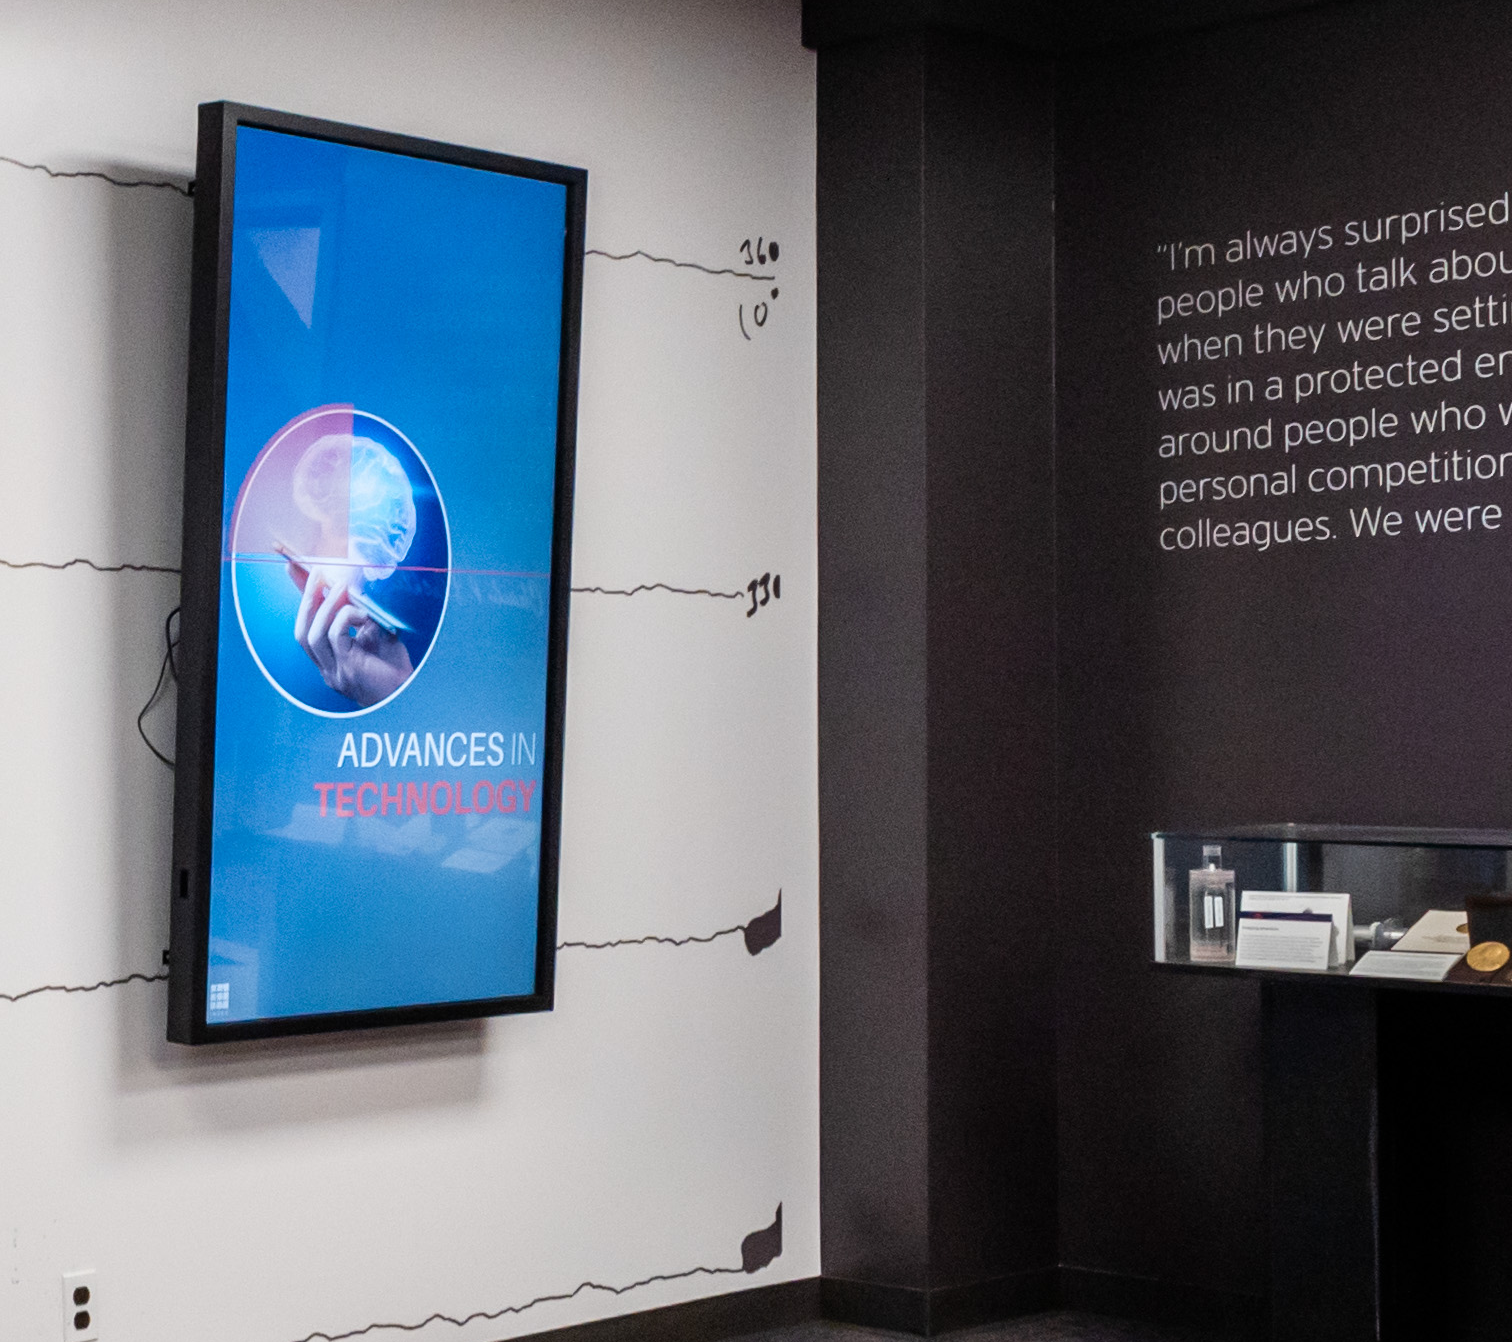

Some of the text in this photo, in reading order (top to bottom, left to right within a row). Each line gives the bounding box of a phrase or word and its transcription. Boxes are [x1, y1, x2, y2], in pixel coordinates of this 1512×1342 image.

[1226, 225, 1332, 263] always
[1345, 192, 1509, 245] surprised
[1158, 280, 1264, 324] people
[1275, 271, 1345, 302] who
[1357, 257, 1417, 293] talk
[1158, 334, 1242, 364] when
[1254, 323, 1325, 354] they
[1338, 312, 1421, 343] were
[1159, 384, 1216, 410] was
[1228, 375, 1253, 403] in
[1265, 376, 1283, 400] a
[1296, 349, 1461, 403] protected
[1159, 419, 1272, 458] around
[1285, 408, 1398, 453] people
[1411, 401, 1486, 434] who
[1160, 464, 1296, 509] personal
[1160, 516, 1336, 551] colleagues.
[1350, 507, 1403, 537] We
[1415, 505, 1502, 533] were
[337, 732, 536, 768] ADVANCES IN
[314, 779, 537, 818] TECHNOLOGY
